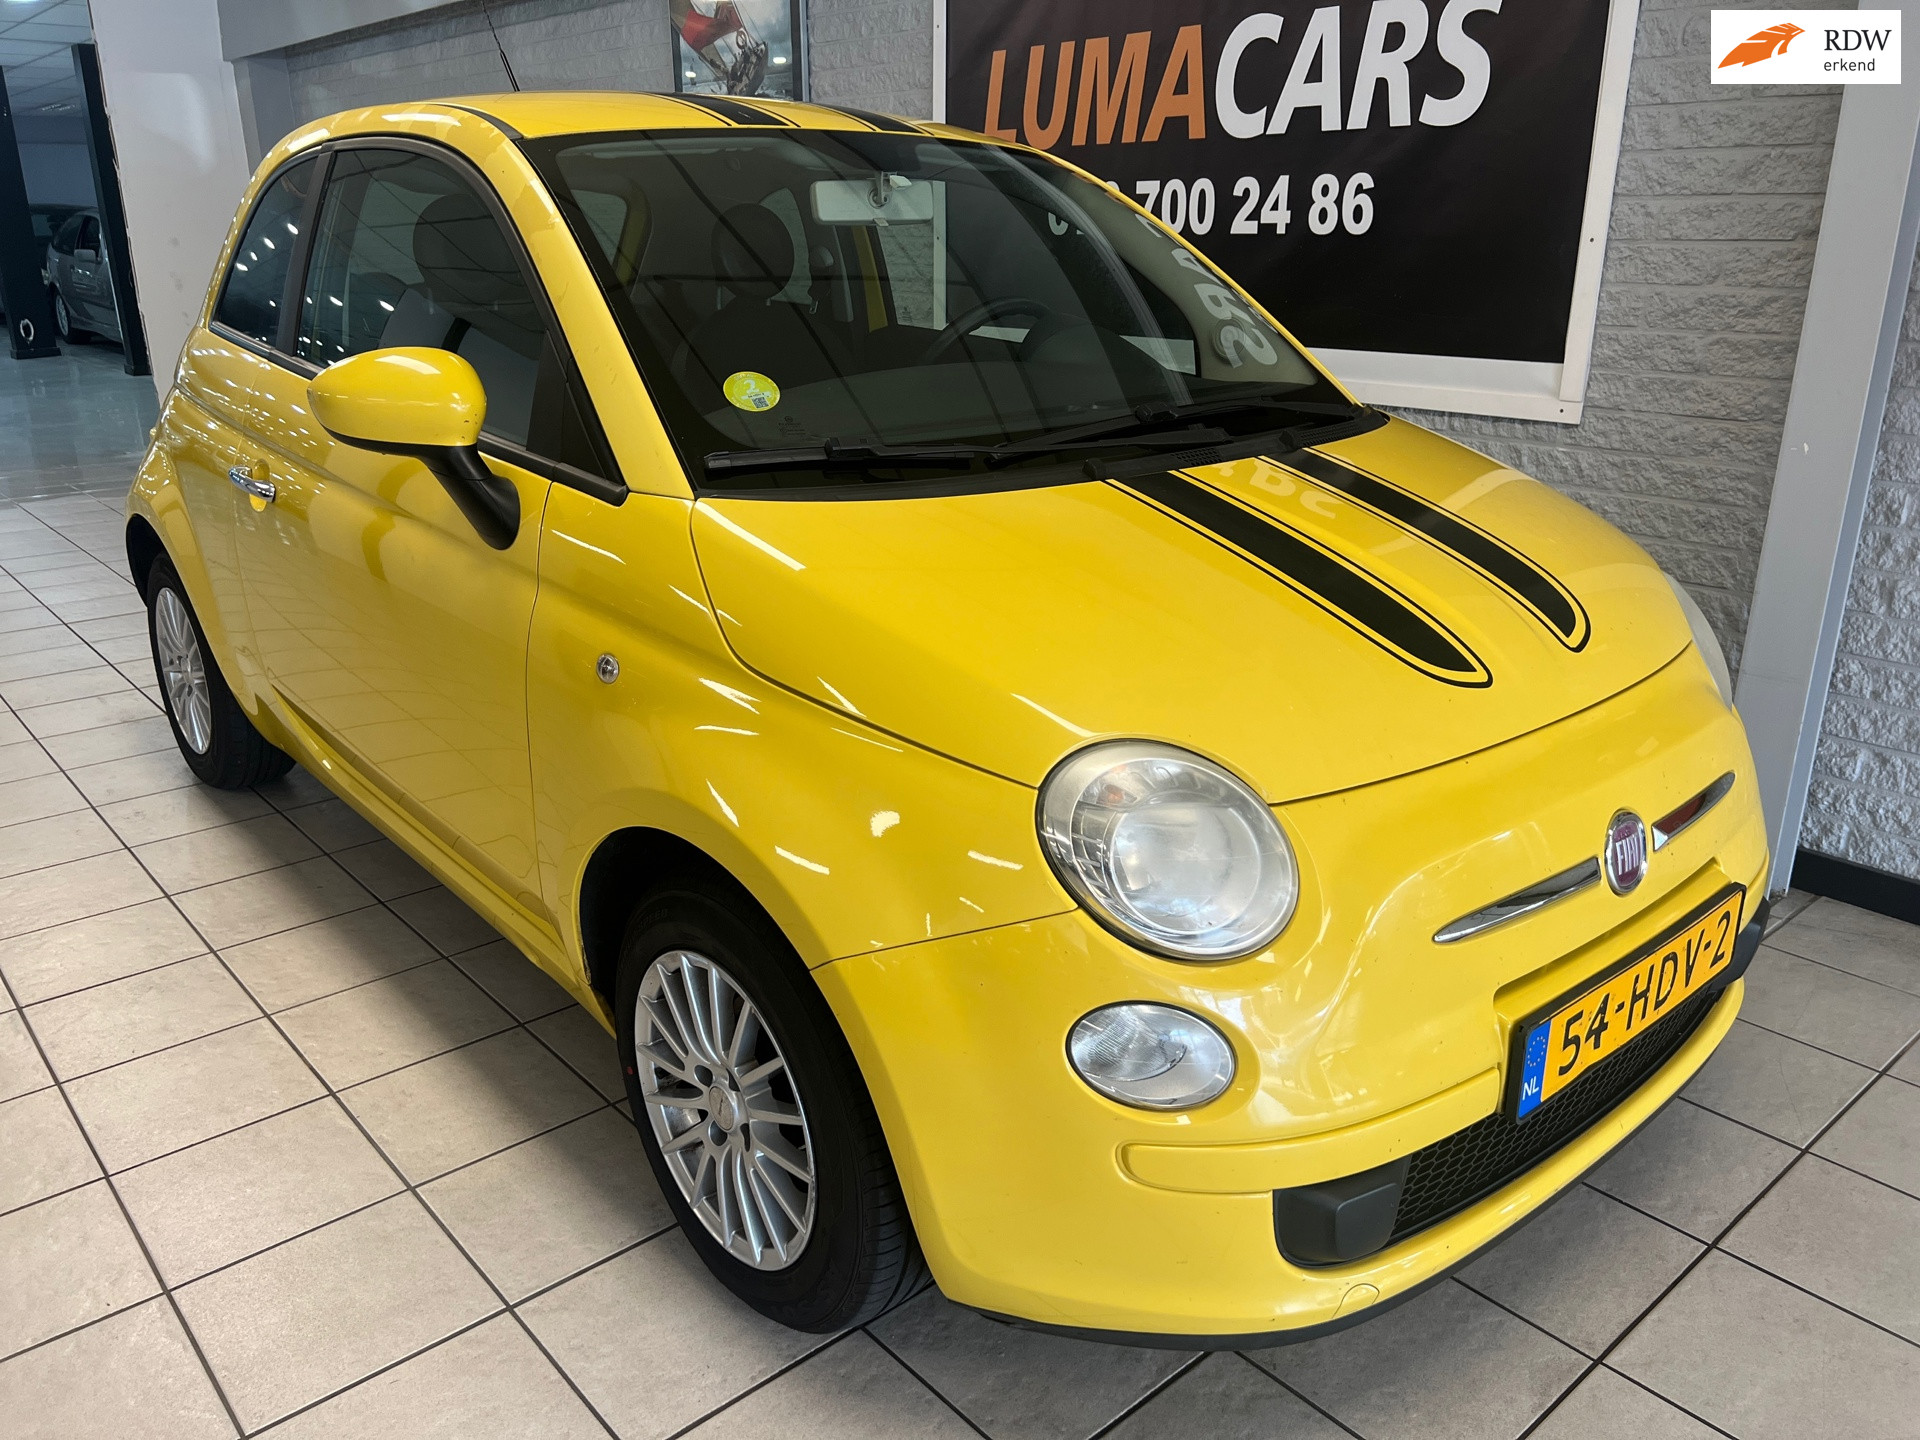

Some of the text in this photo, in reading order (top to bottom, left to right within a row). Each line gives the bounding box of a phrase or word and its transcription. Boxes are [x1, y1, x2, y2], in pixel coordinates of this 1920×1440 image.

[1230, 174, 1291, 235] 24
[1307, 172, 1375, 235] 86
[743, 380, 760, 394] 2
[1616, 834, 1639, 875] FIAT
[1558, 910, 1731, 1076] 54-HDV-2
[1521, 1075, 1540, 1101] NL
